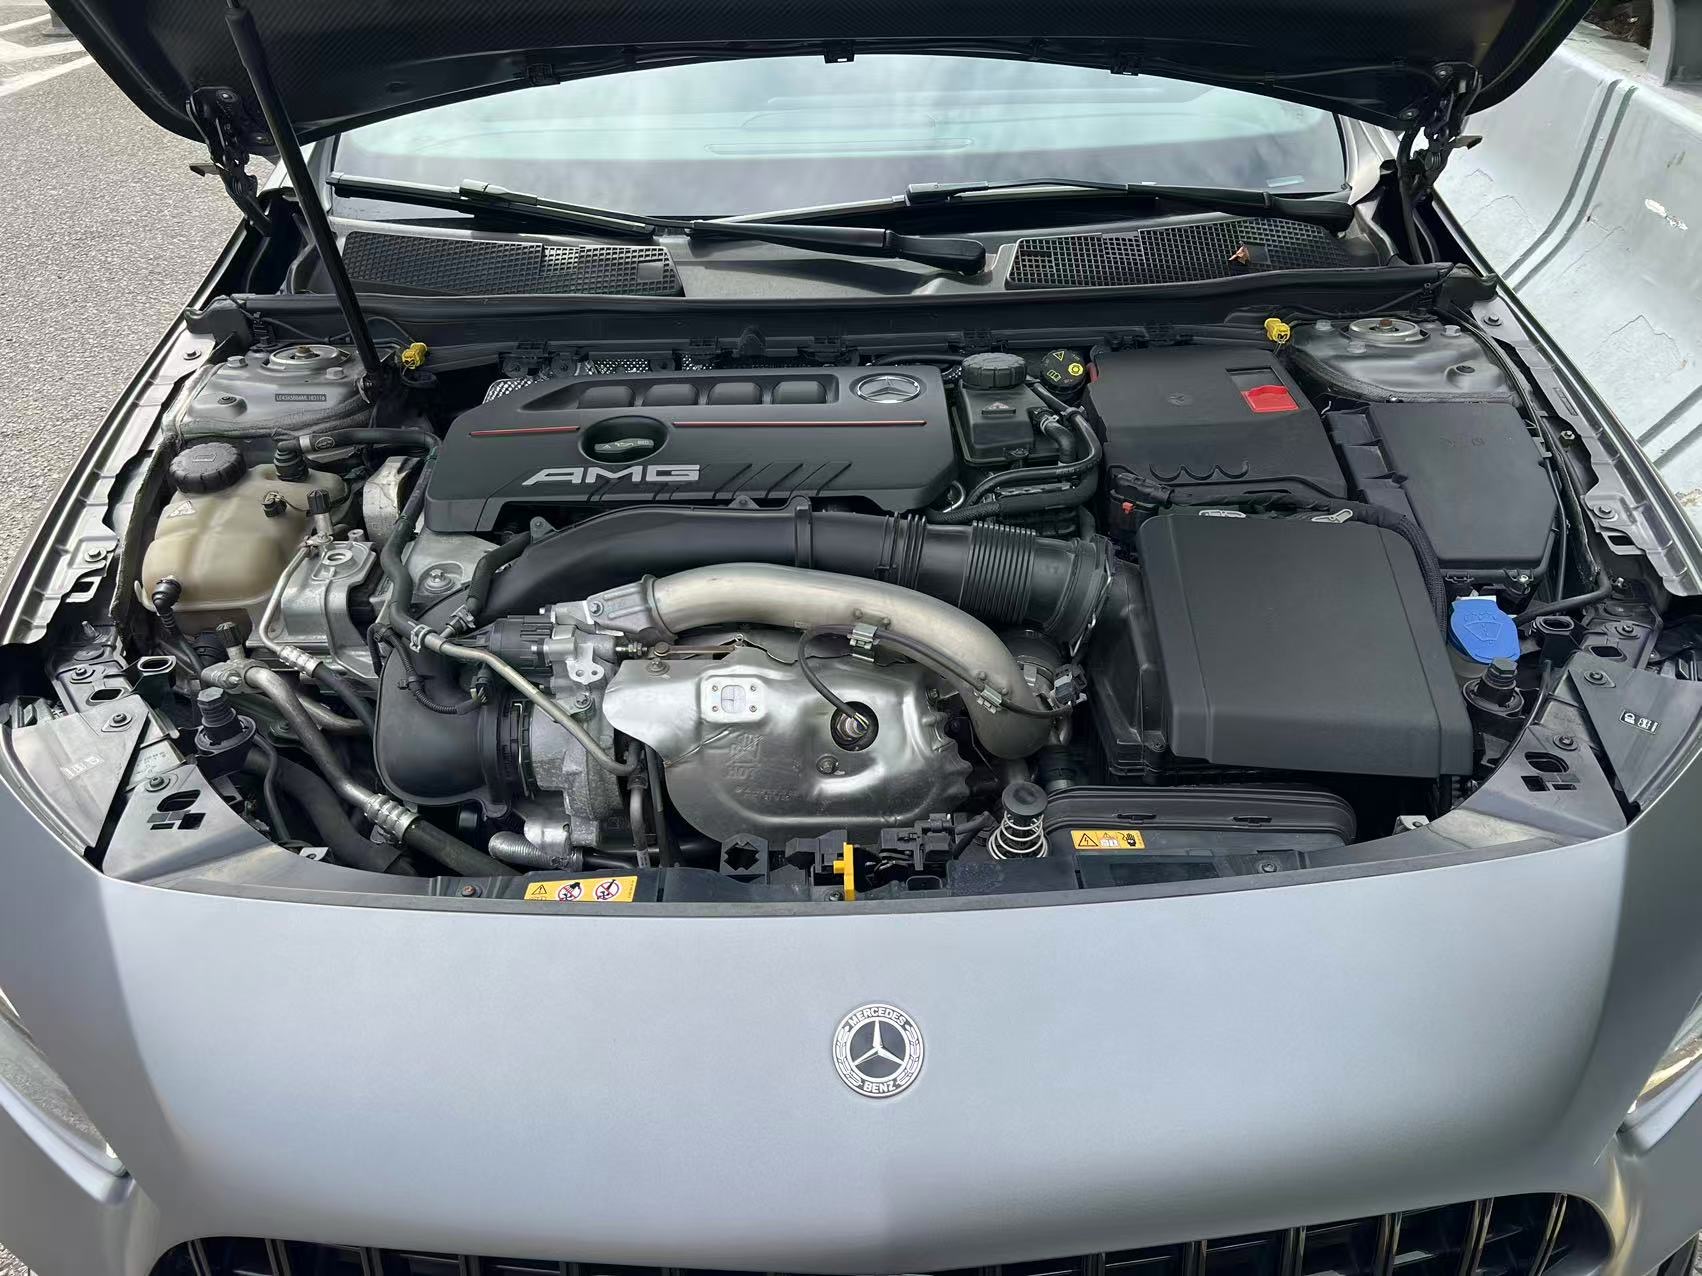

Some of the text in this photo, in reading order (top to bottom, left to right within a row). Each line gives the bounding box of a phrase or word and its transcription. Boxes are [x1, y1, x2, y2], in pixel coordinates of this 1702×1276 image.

[522, 465, 700, 485] AMG
[848, 1007, 906, 1026] MERCEDES
[863, 1081, 896, 1093] BENZ
